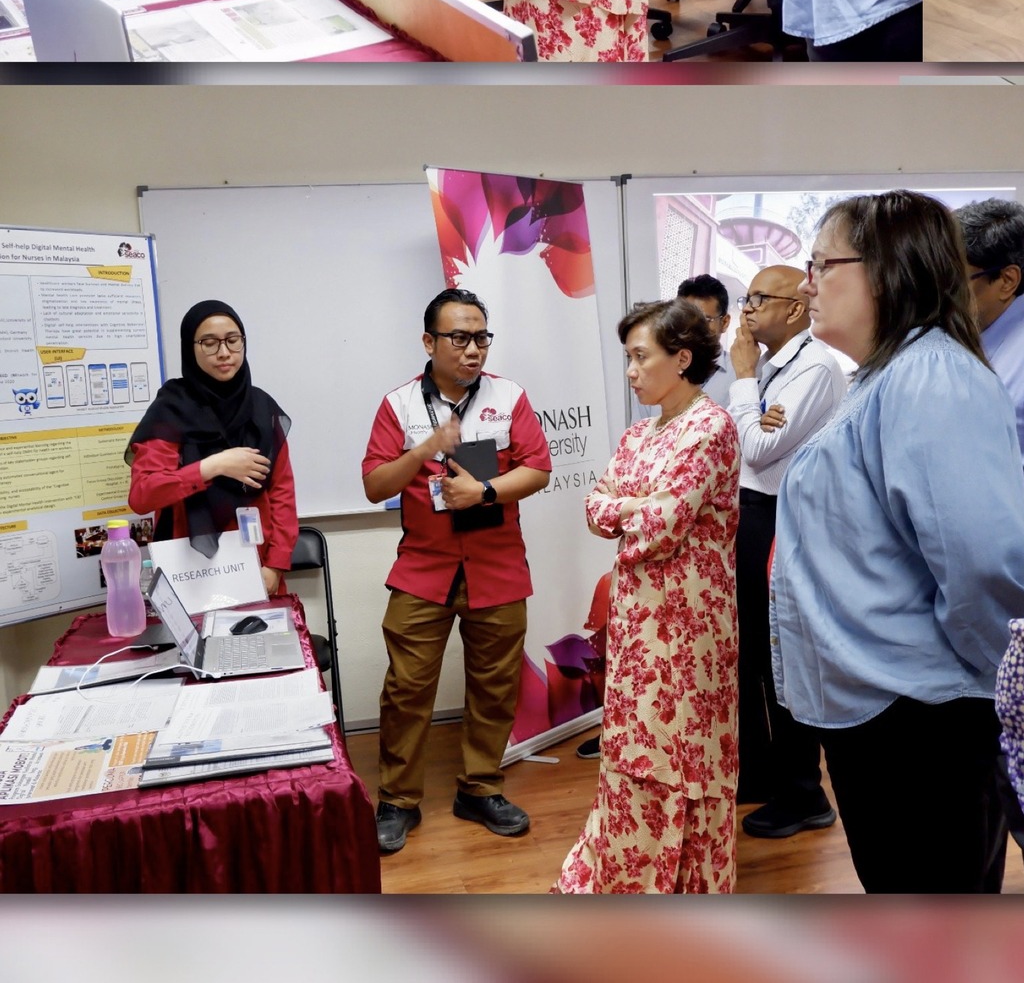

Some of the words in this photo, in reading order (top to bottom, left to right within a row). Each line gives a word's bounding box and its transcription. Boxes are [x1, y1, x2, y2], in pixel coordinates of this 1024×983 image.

[1, 242, 30, 251] Self-help
[31, 243, 52, 252] Digital
[53, 244, 75, 252] Mental
[76, 245, 96, 253] Health
[124, 250, 146, 259] seaco
[487, 414, 512, 422] seaco
[534, 405, 592, 432] NASH
[547, 433, 587, 457] ersity
[540, 470, 598, 494] LAYSIA
[172, 567, 221, 583] RESEARCH
[222, 562, 245, 574] UNIT
